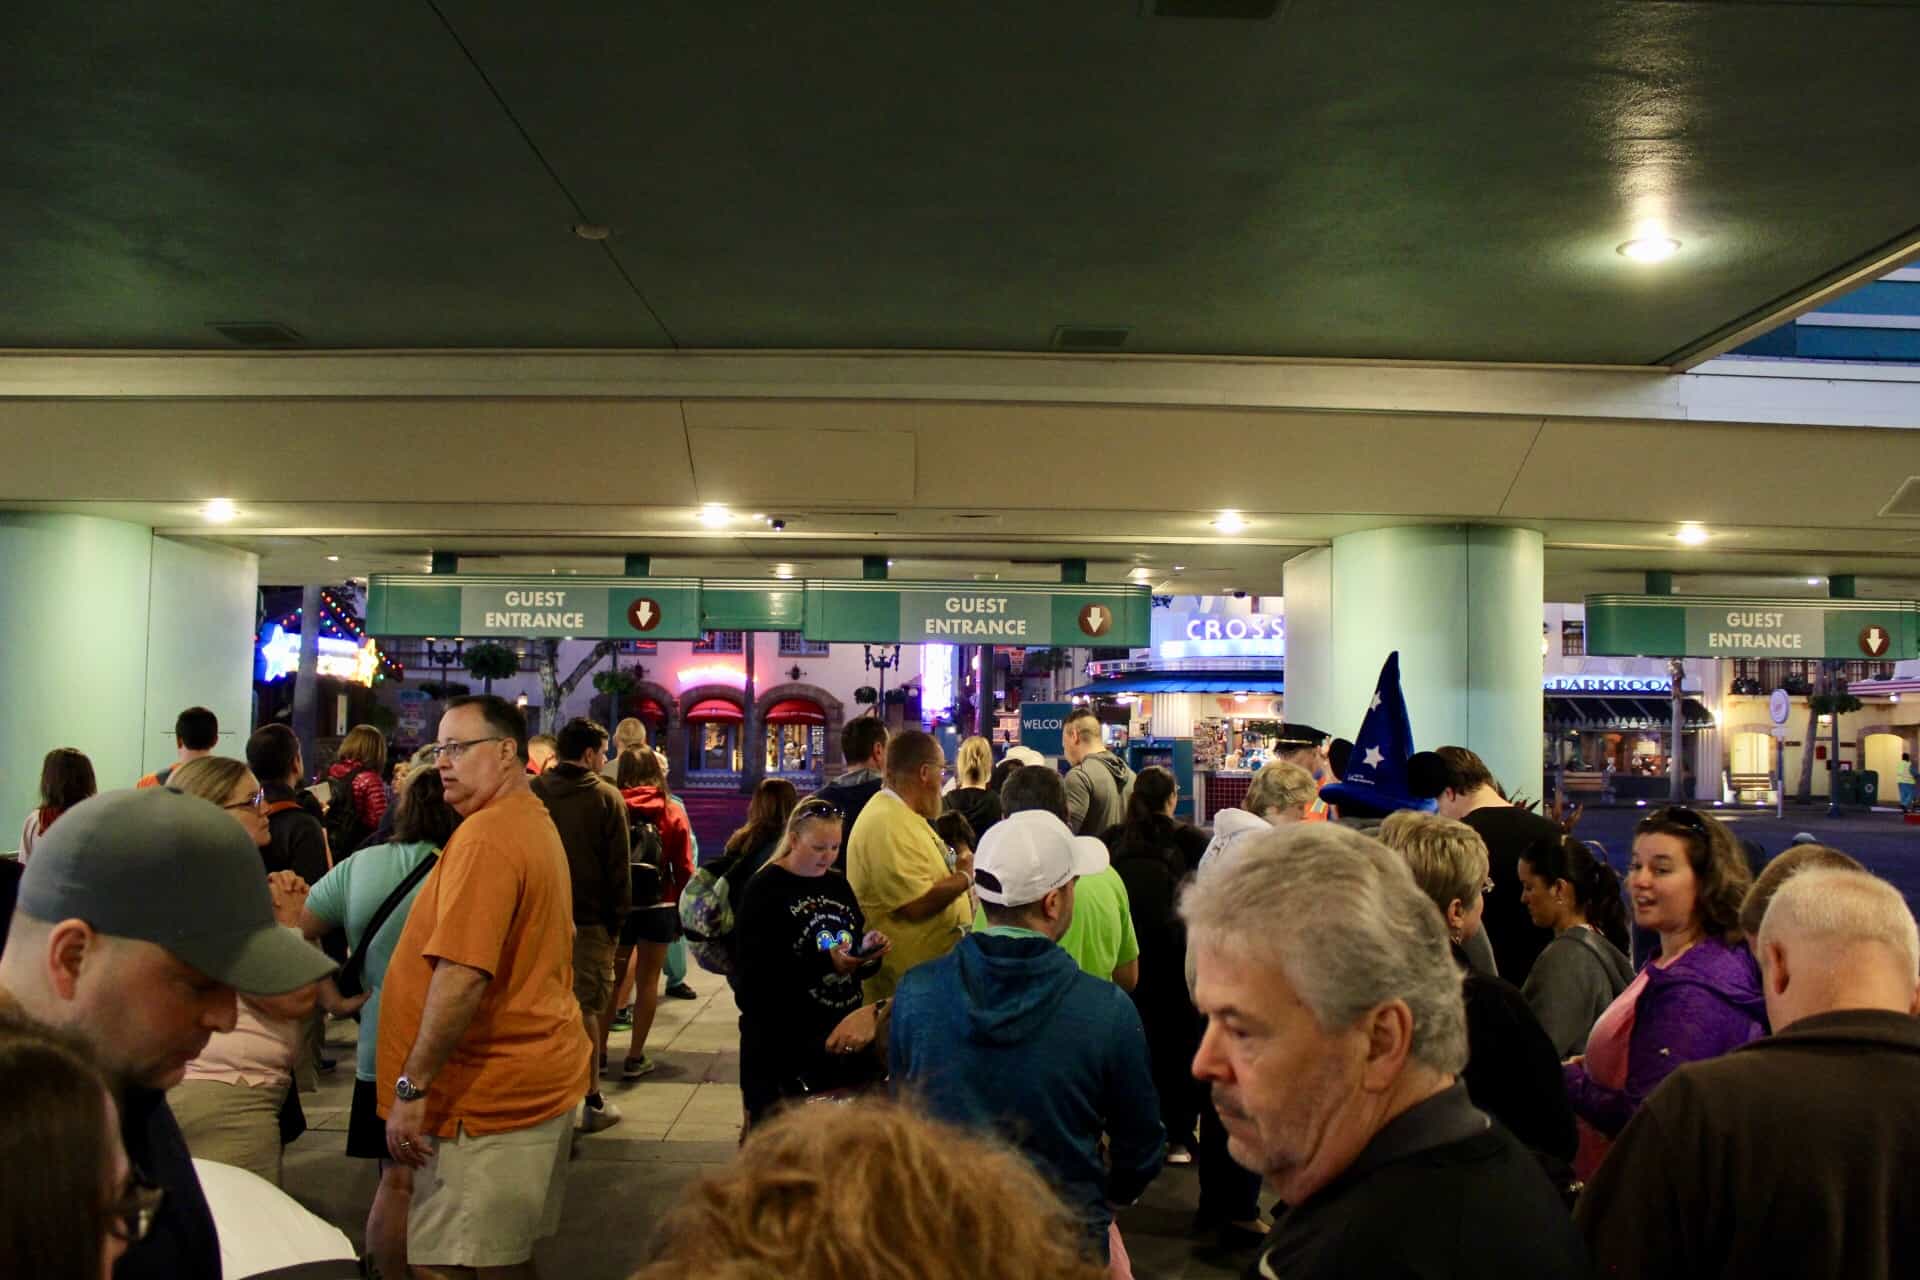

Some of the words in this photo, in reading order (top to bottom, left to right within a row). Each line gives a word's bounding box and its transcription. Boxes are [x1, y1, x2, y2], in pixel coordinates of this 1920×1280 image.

[504, 591, 567, 607] GUEST
[945, 597, 1008, 613] GUEST
[485, 612, 584, 628] ENTRANCE
[925, 618, 1026, 635] ENTRANCE
[1727, 612, 1785, 628] GUEST
[1708, 632, 1802, 648] ENTRANCE
